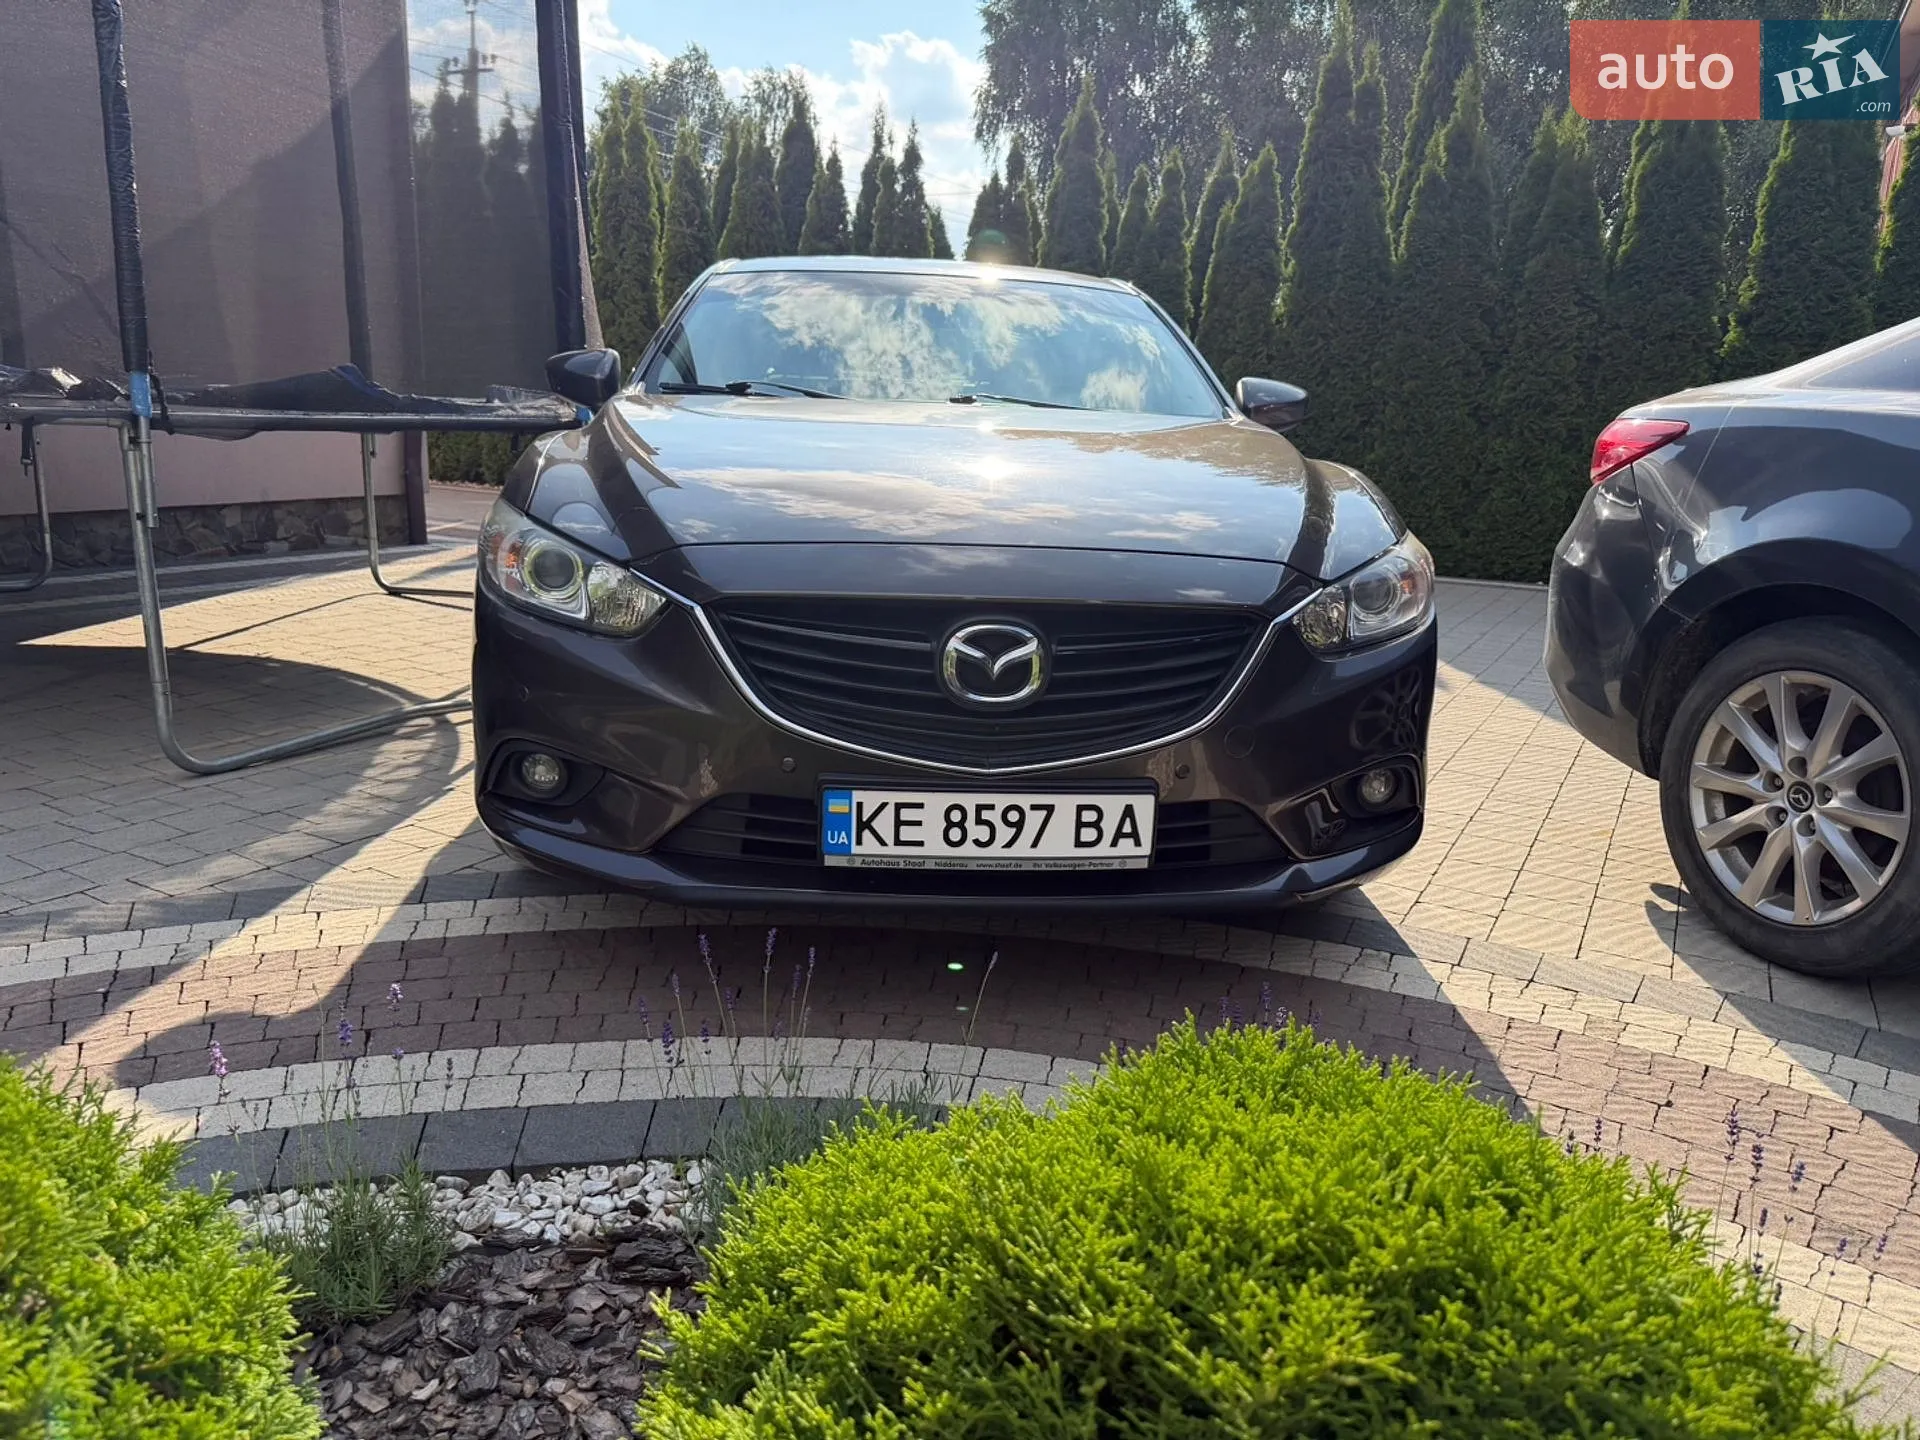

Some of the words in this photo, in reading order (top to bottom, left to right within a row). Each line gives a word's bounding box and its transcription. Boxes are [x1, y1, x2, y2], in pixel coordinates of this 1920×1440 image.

[855, 801, 925, 847] KE
[942, 803, 1056, 849] 8597
[1073, 803, 1143, 849] BA
[827, 831, 849, 845] UA
[860, 858, 900, 868] Autohaus
